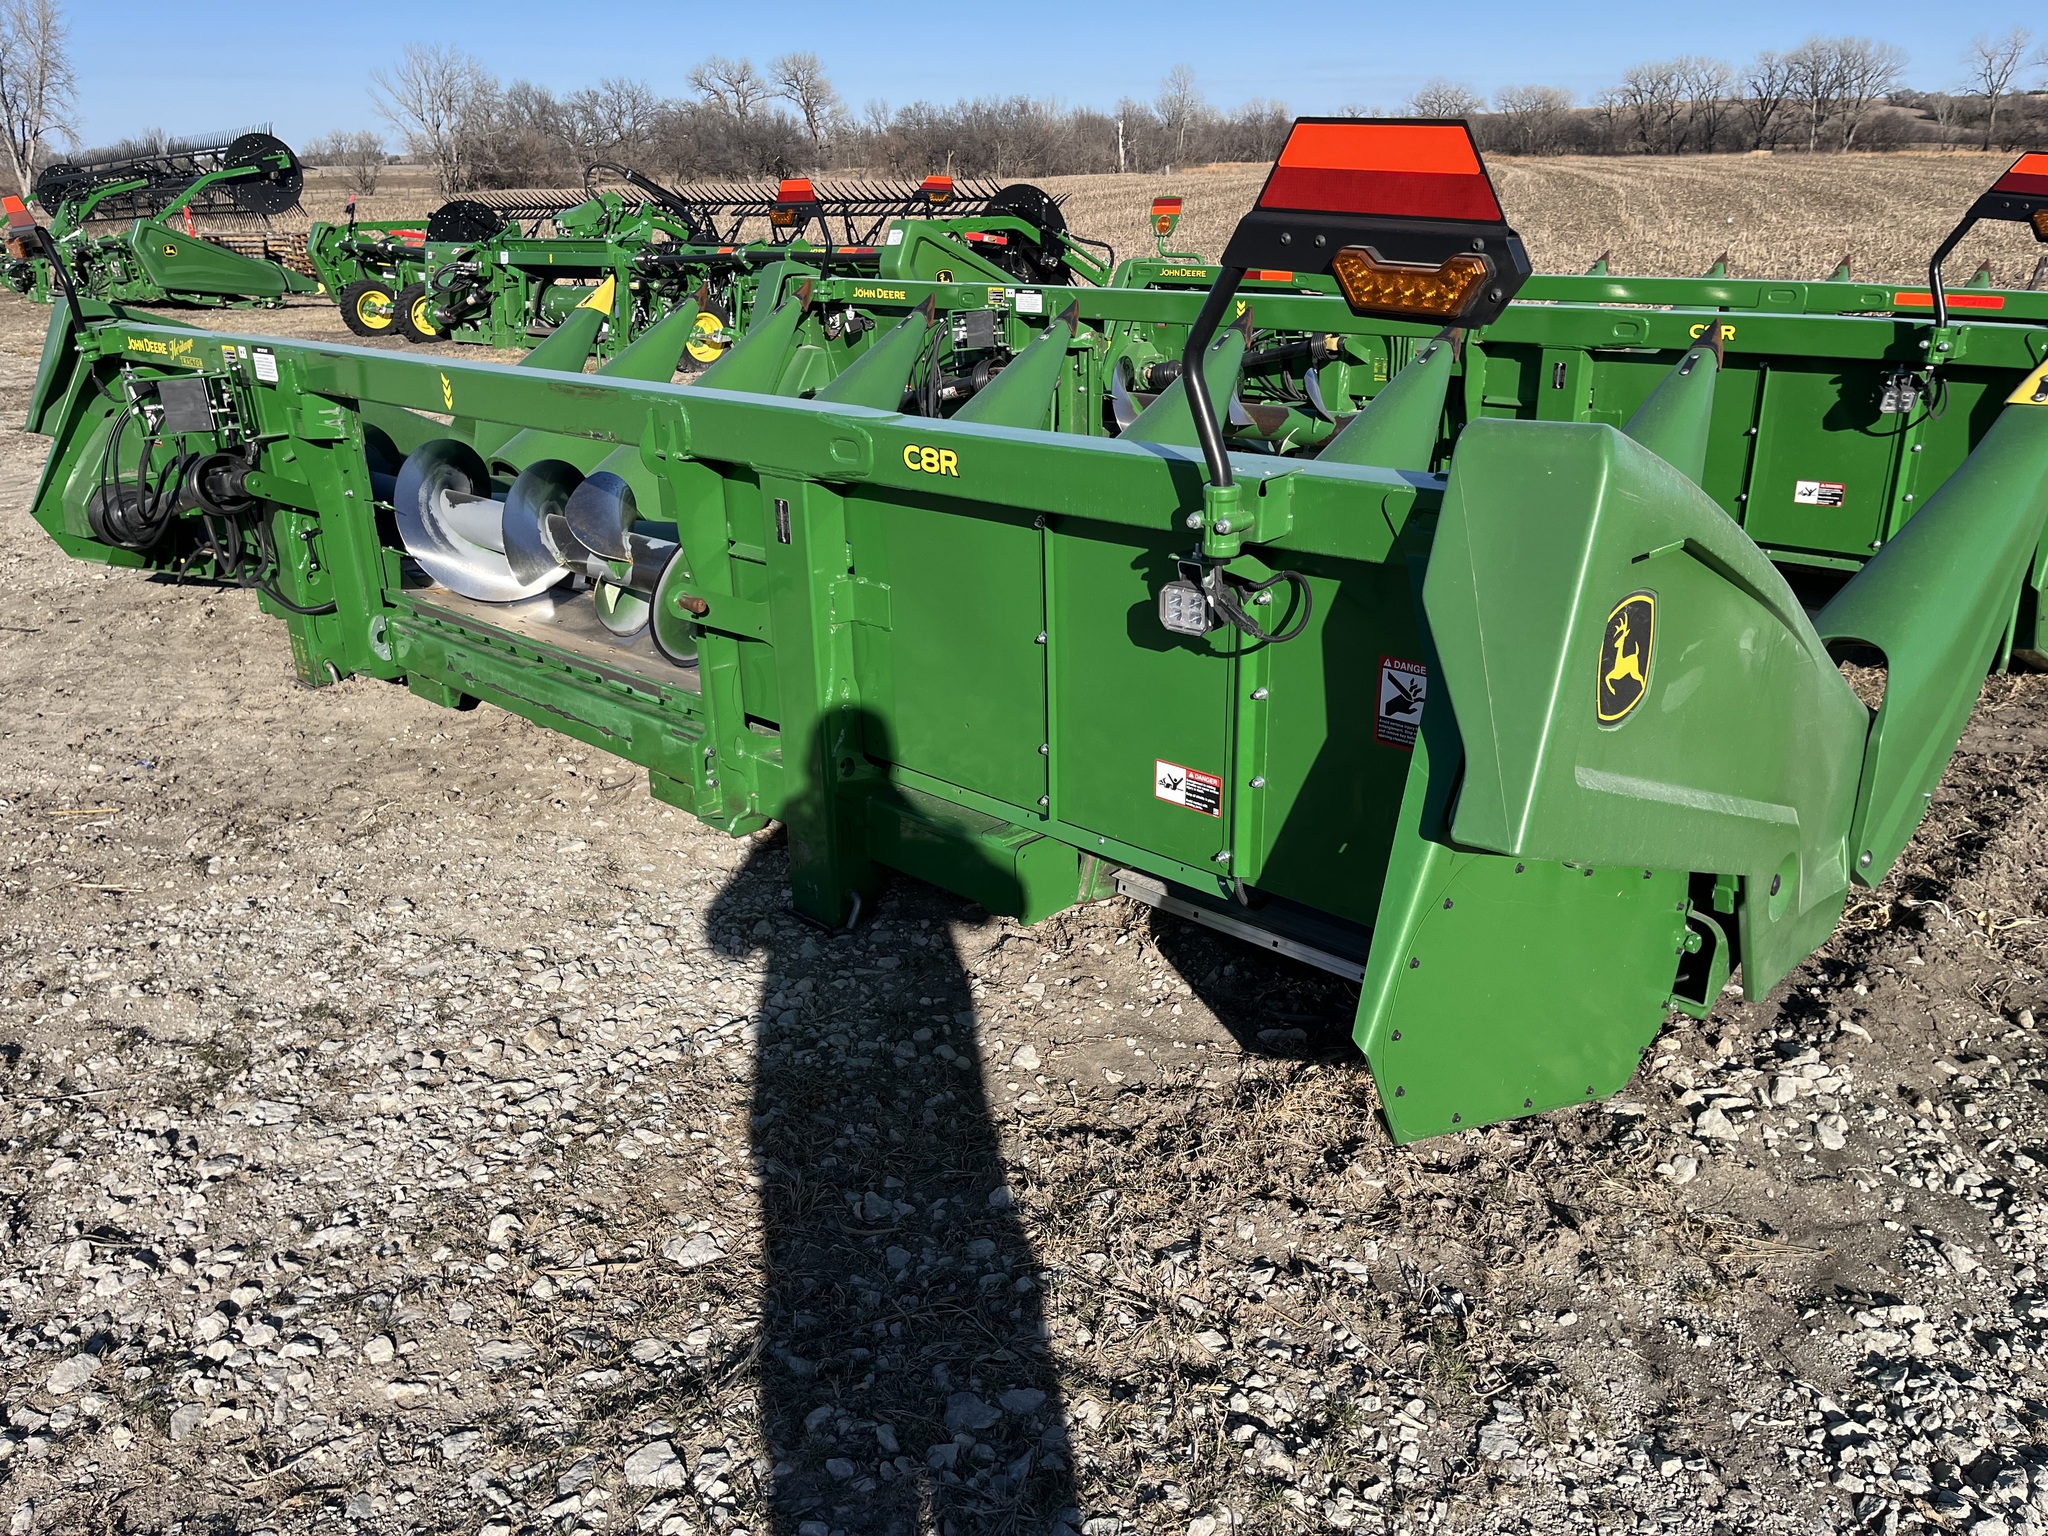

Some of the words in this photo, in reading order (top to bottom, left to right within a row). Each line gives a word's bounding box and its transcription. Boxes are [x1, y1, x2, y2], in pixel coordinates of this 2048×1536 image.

[1159, 268, 1180, 277] JOHN
[1180, 268, 1207, 278] DEERE
[853, 287, 876, 299] JOHN
[876, 288, 906, 300] DEERE
[1689, 323, 1737, 341] CR
[128, 336, 145, 352] JOHN
[144, 338, 168, 355] DEERE
[903, 443, 960, 478] C8R
[1394, 660, 1426, 675] DANGE
[1194, 773, 1218, 786] DANGER
